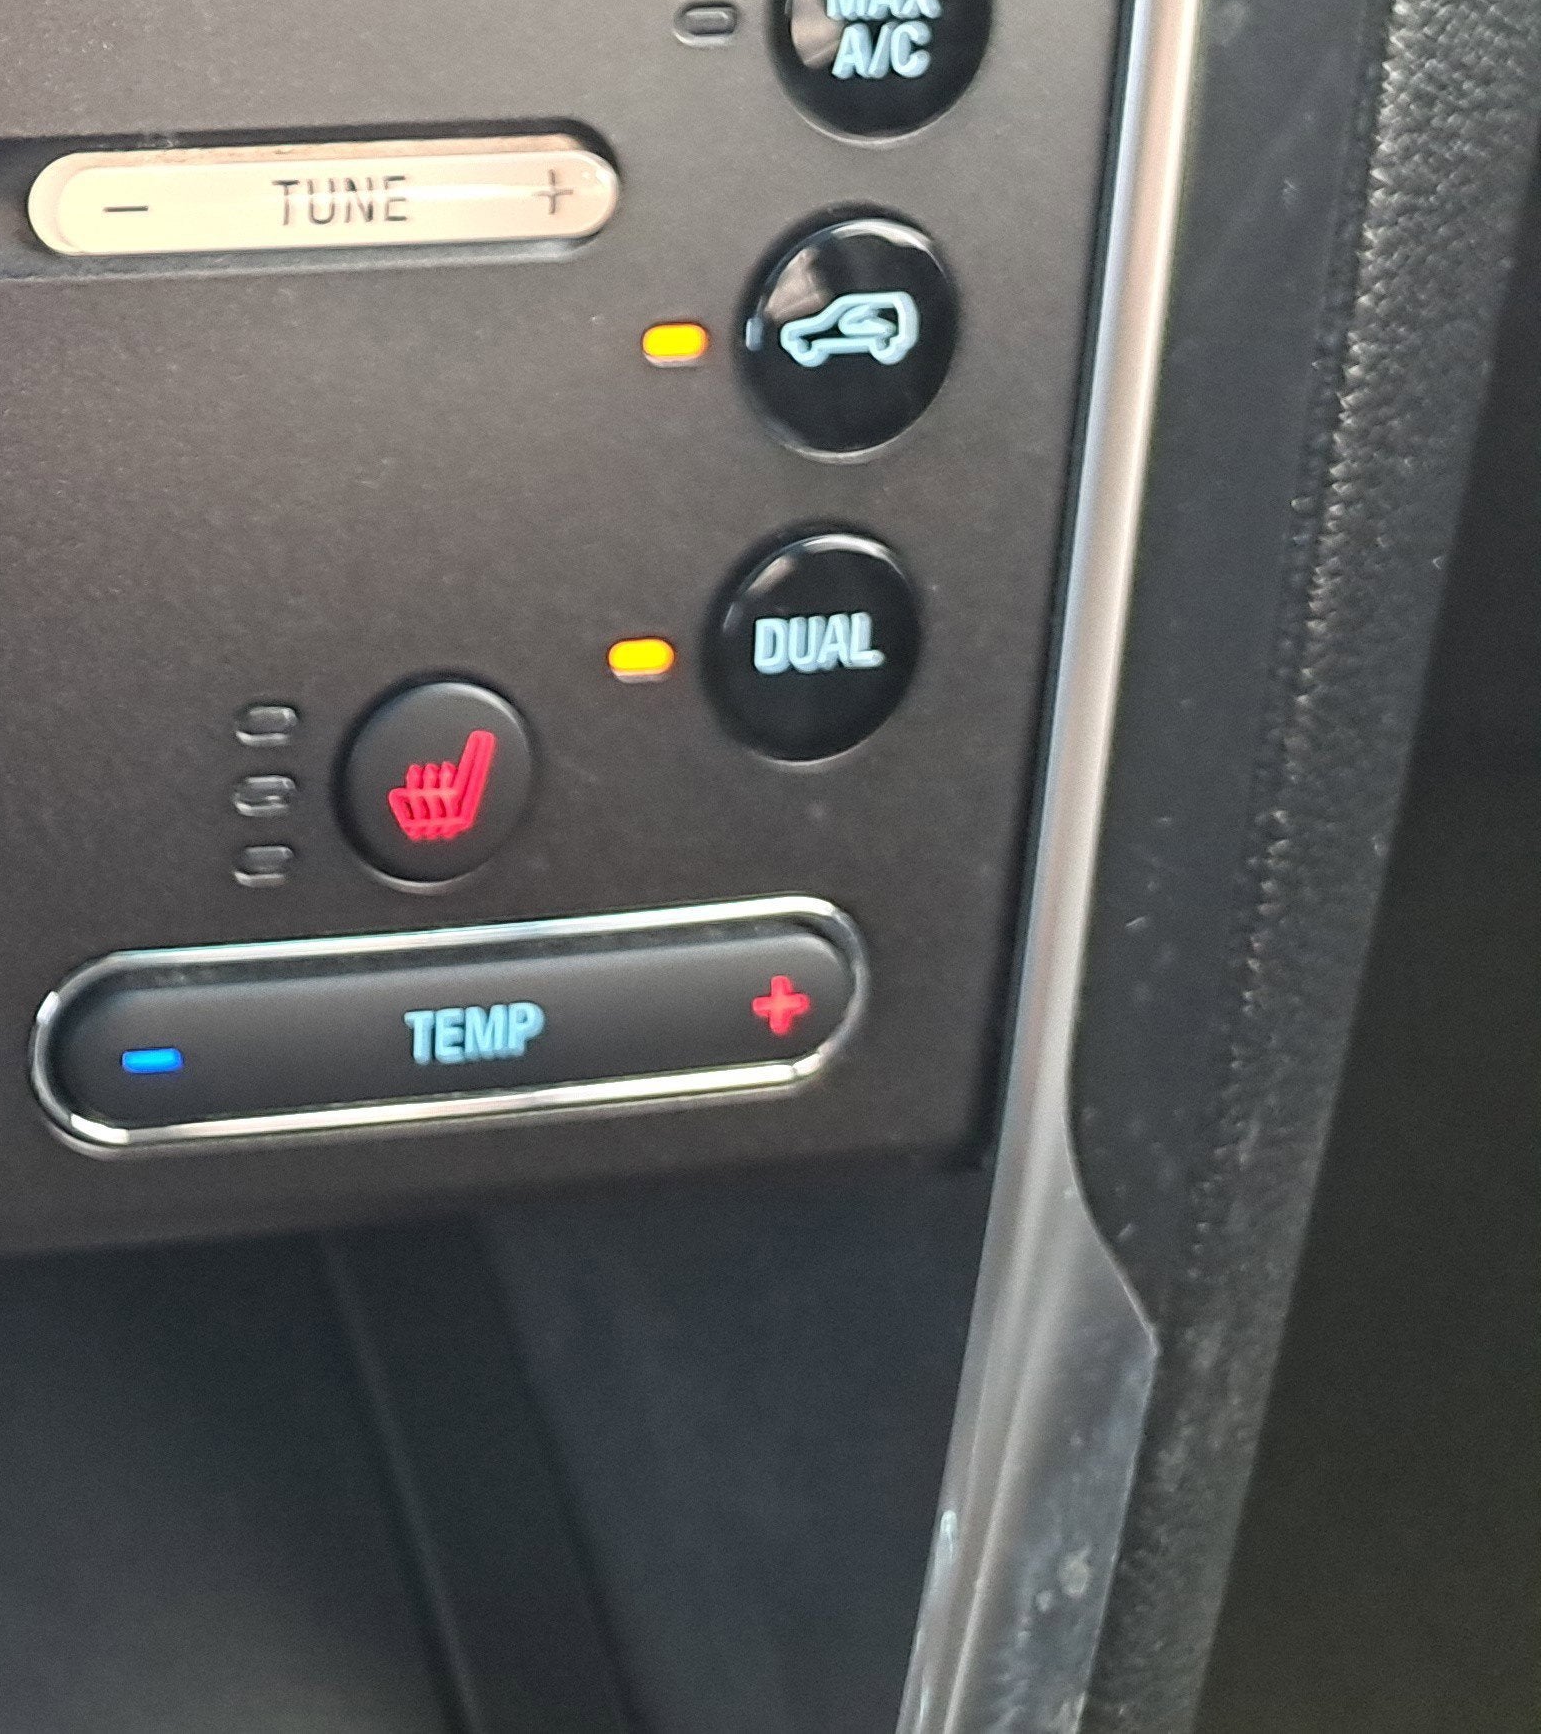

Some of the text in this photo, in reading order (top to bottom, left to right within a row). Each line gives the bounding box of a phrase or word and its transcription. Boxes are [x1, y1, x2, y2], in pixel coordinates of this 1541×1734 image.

[830, 20, 931, 79] A/C
[272, 175, 408, 226] TUNE
[754, 611, 885, 674] DUAL
[405, 1002, 545, 1064] TEMP
